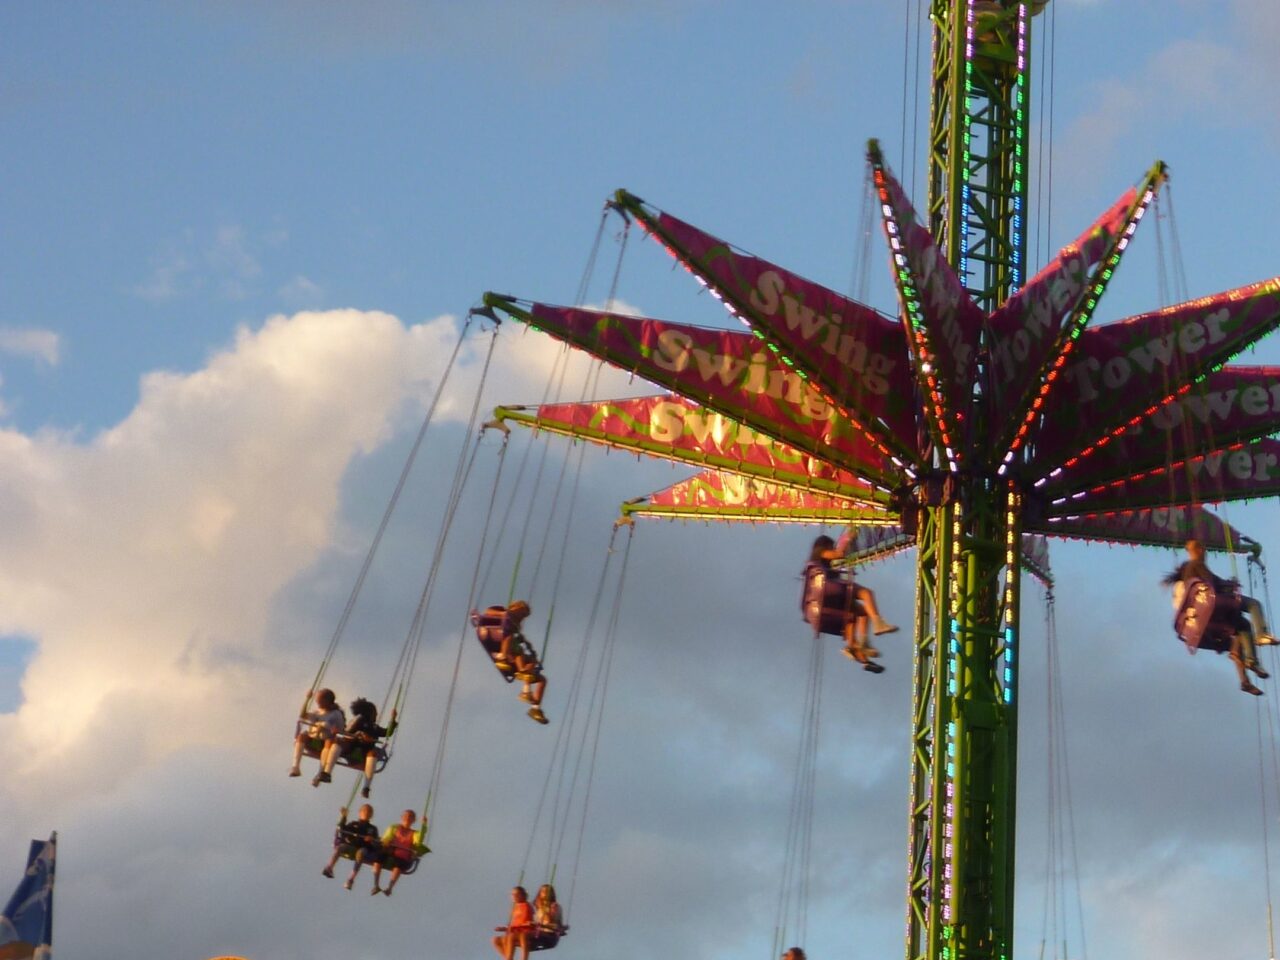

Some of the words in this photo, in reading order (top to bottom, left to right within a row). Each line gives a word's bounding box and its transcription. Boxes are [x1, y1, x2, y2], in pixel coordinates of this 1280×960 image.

[653, 329, 836, 421] Swing
[751, 269, 897, 396] Swing
[1067, 305, 1232, 398] Tower
[1192, 446, 1278, 482] wer
